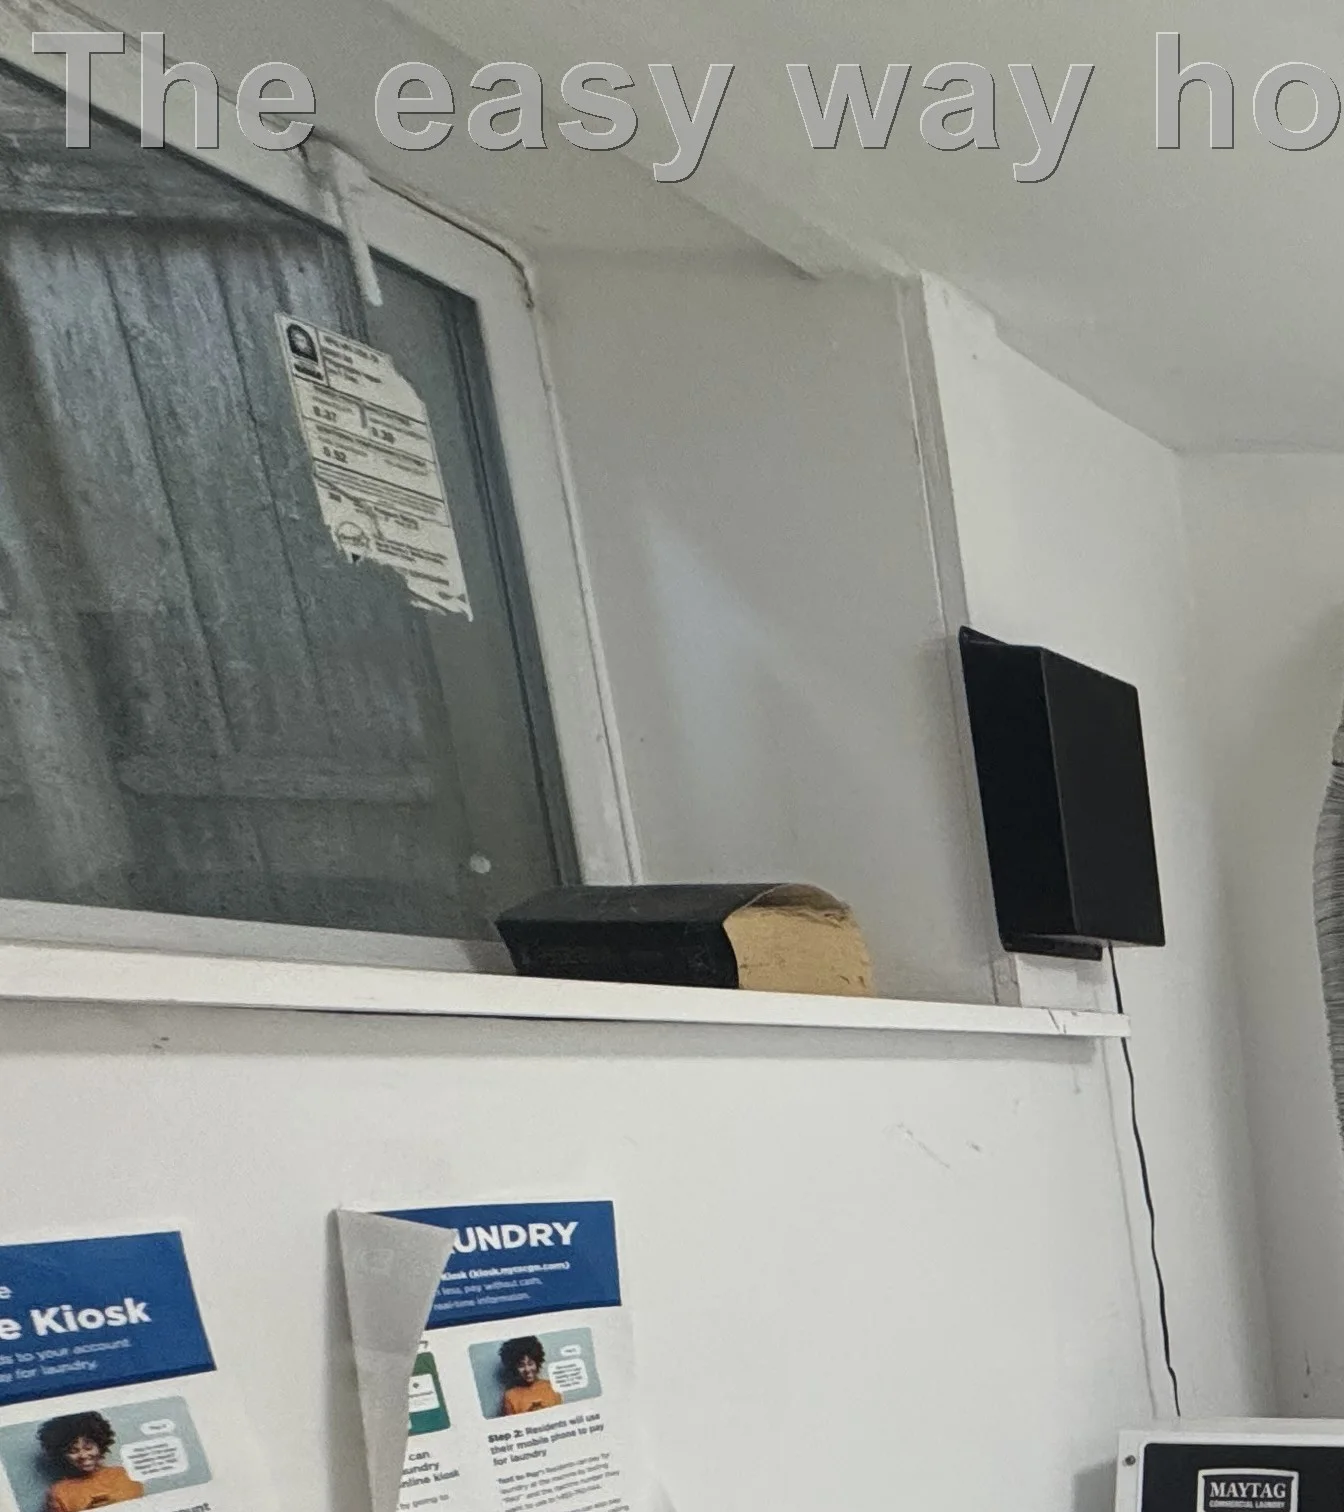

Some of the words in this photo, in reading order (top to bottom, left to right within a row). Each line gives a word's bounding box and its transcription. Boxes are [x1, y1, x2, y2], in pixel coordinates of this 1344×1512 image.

[449, 1221, 579, 1254] UNDRY
[30, 1297, 152, 1337] Kiosk
[488, 1432, 512, 1443] Step
[514, 1429, 524, 1440] 2:
[526, 1419, 567, 1435] Residents
[570, 1415, 584, 1426] will
[586, 1413, 601, 1423] use
[490, 1443, 514, 1455] their
[516, 1436, 549, 1450] mobile
[551, 1430, 576, 1443] phone
[590, 1424, 604, 1435] pay
[493, 1457, 508, 1466] for
[510, 1450, 547, 1463] laundry
[1210, 1482, 1286, 1498] MAYTAG
